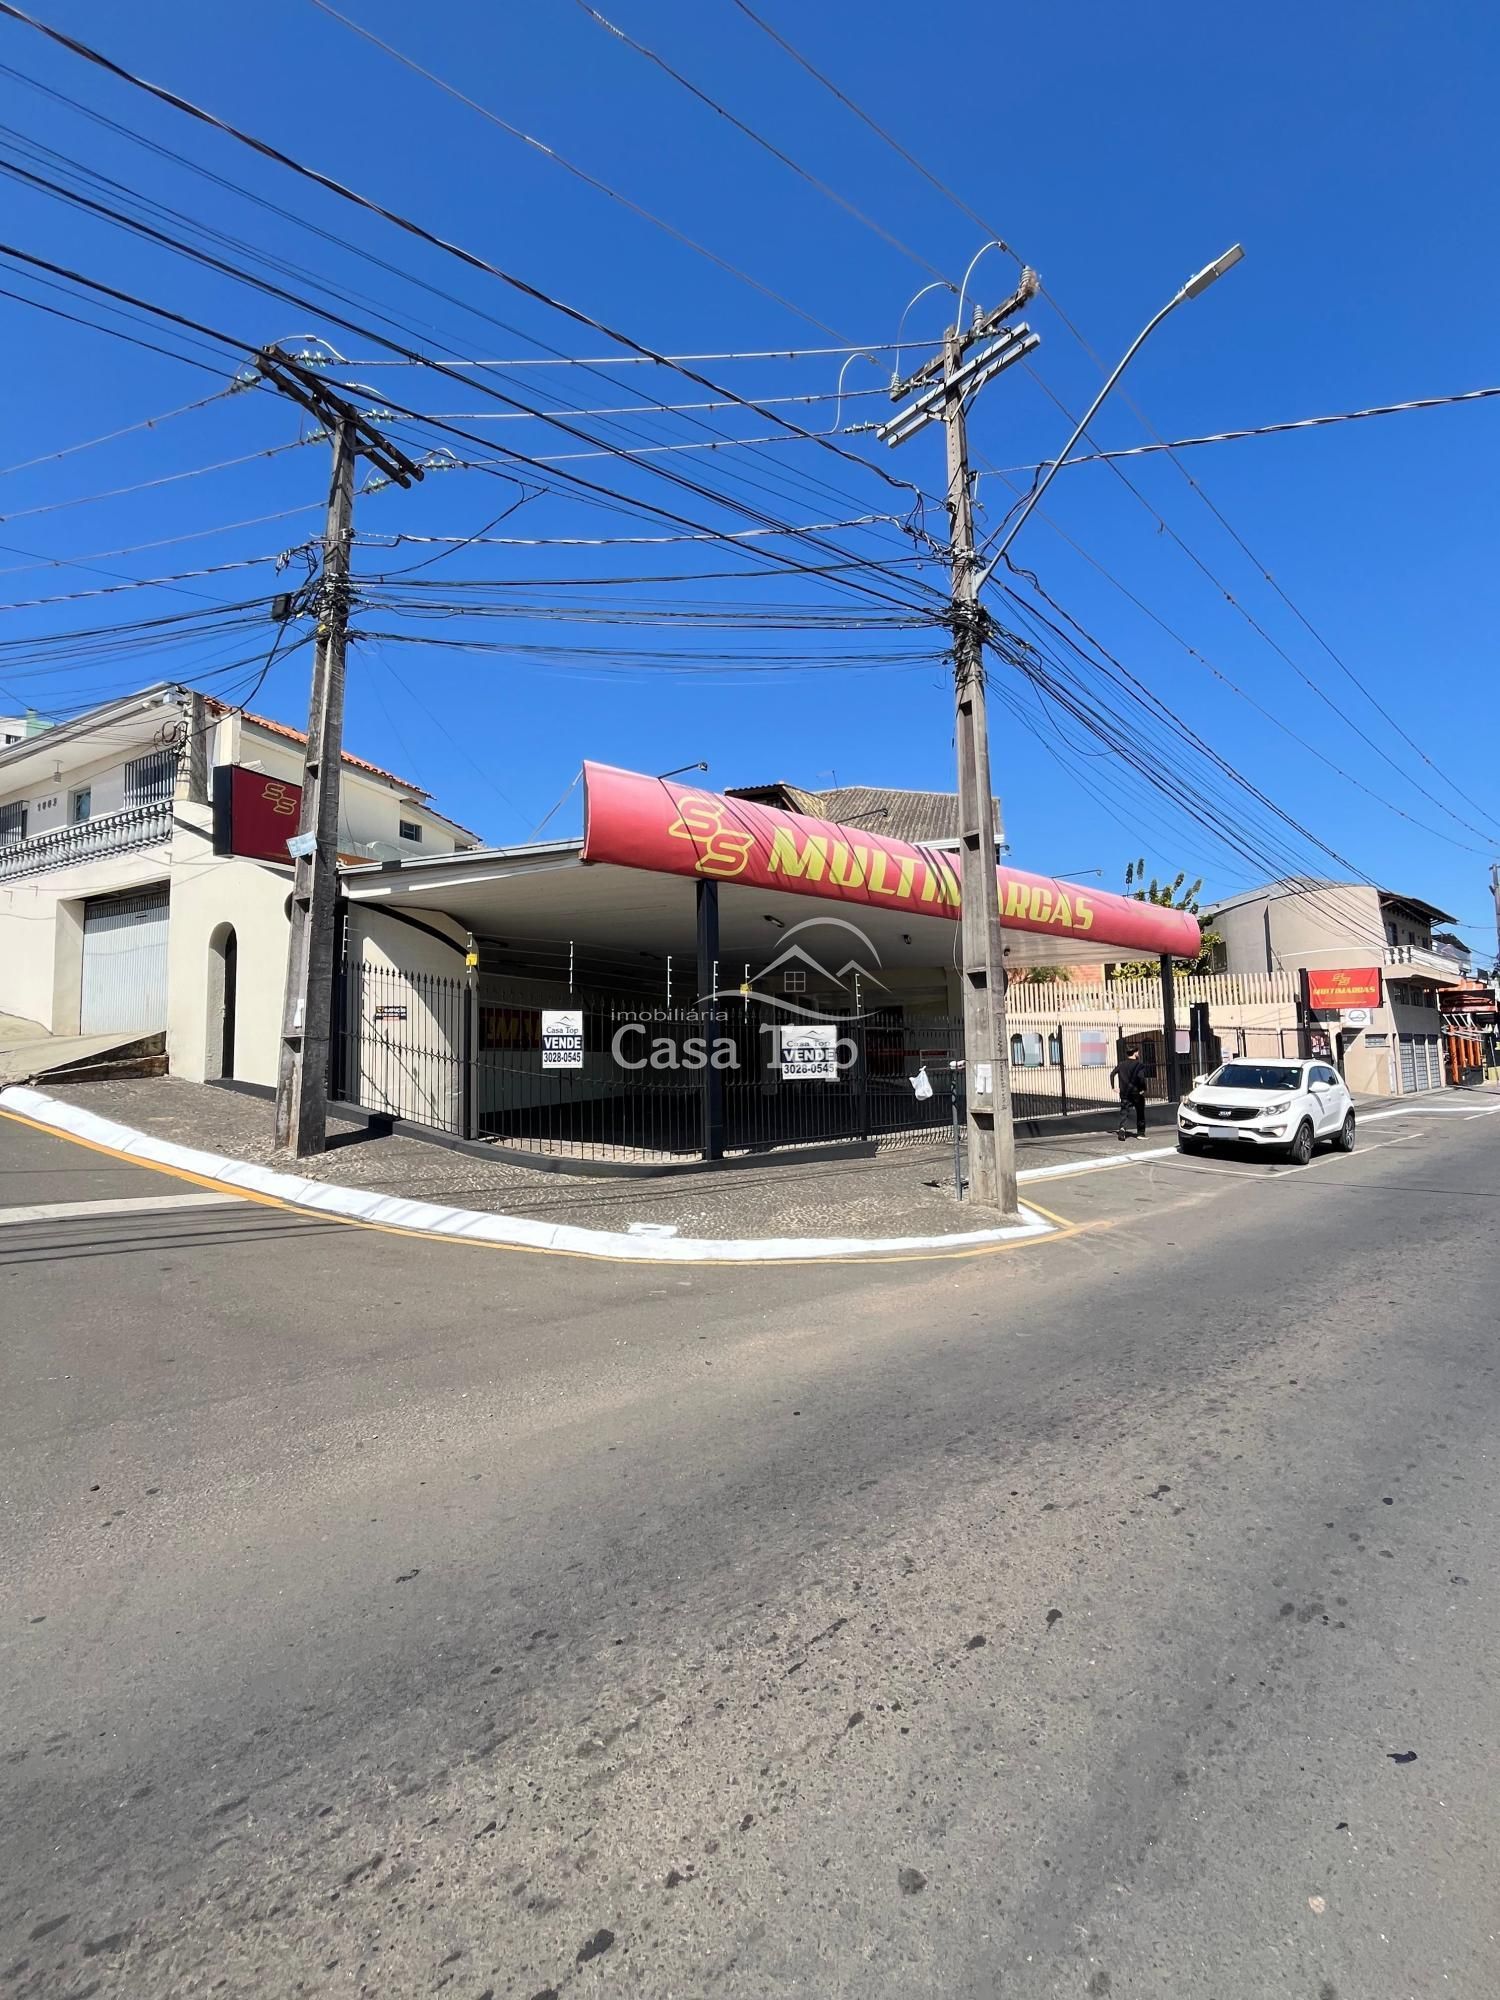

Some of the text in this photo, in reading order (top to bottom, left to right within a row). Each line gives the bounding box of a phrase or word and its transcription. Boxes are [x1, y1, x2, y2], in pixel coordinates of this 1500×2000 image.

[767, 826, 1093, 930] MULTIMRCAS
[566, 1027, 578, 1035] Top
[544, 1037, 581, 1049] VENDE
[544, 1052, 581, 1062] 3028-0545
[783, 1050, 835, 1061] VENDE
[783, 1063, 835, 1074] 3028-0545
